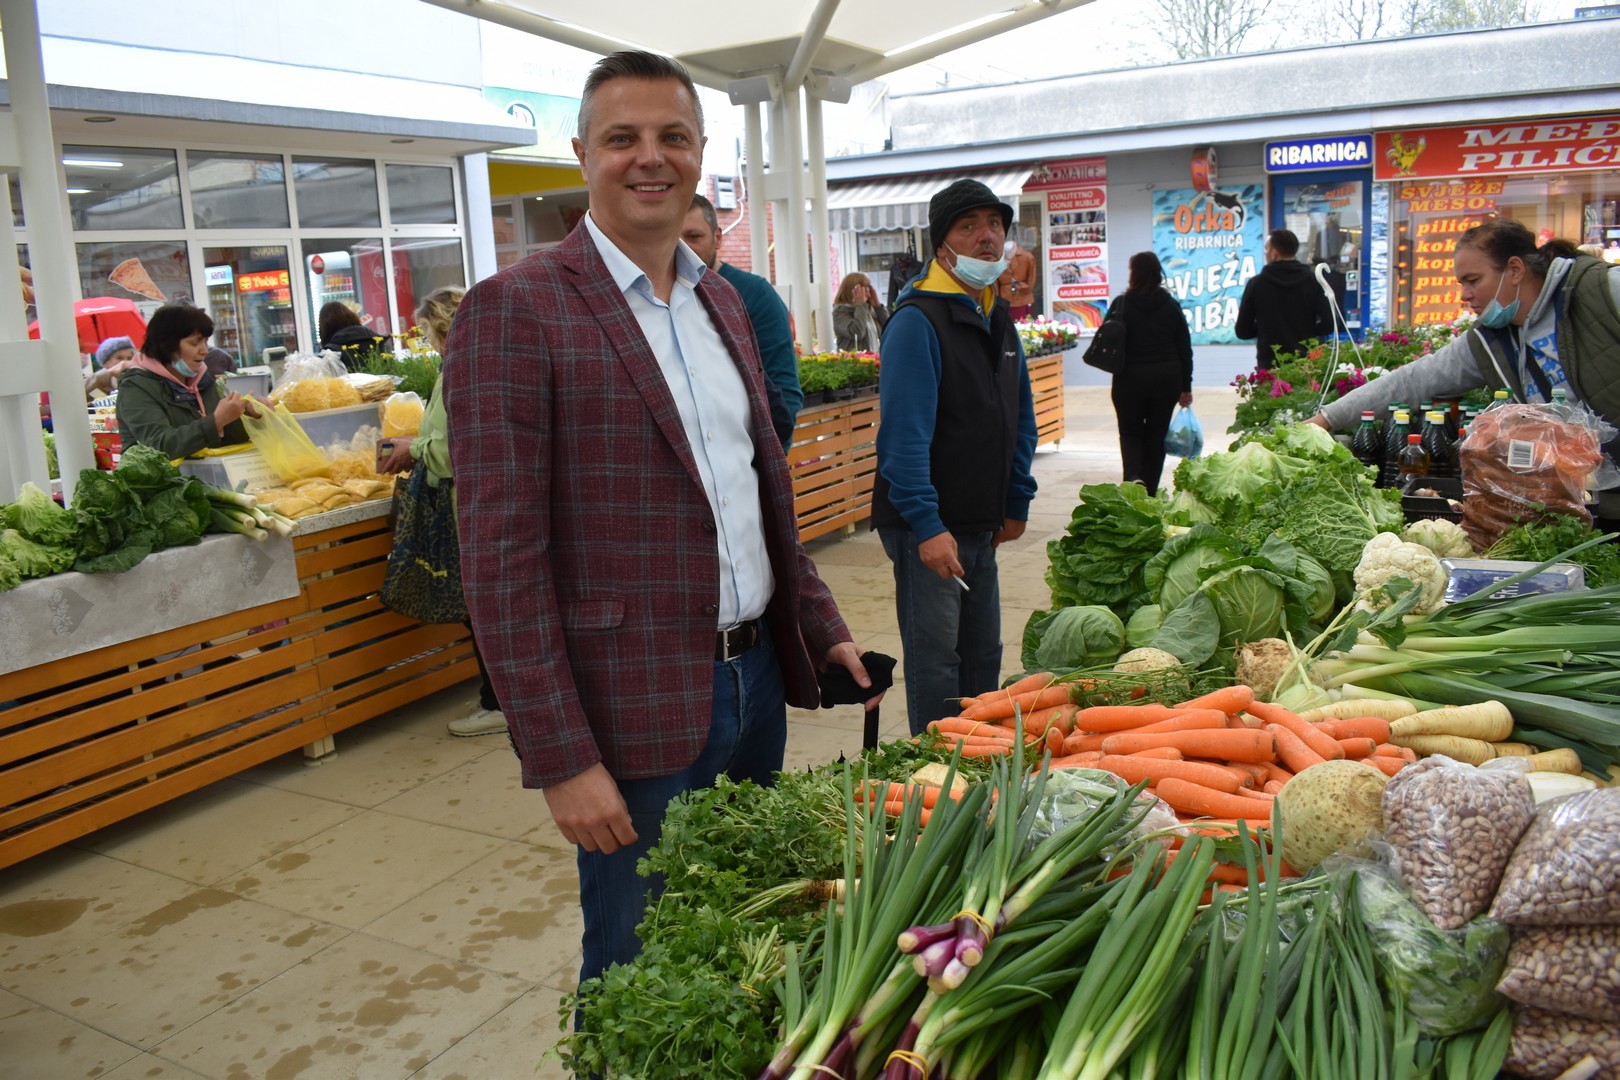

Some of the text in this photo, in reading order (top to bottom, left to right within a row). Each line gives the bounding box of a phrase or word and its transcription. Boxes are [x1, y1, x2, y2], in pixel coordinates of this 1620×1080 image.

[1270, 141, 1368, 166] RIBARNICA
[1050, 191, 1093, 201] KVALITETNO
[1400, 180, 1503, 199] SVJEŽE
[1050, 198, 1100, 209] DONJE RUBLJE
[1408, 196, 1496, 213] MESO:
[1173, 202, 1235, 234] Orka
[1175, 235, 1244, 250] RIBARNICA
[1416, 238, 1457, 253] kok
[1051, 248, 1100, 259] ŽENSKA ODJEĆA
[1415, 256, 1455, 272] kop
[1060, 287, 1107, 297] MUŠKE MAJICE
